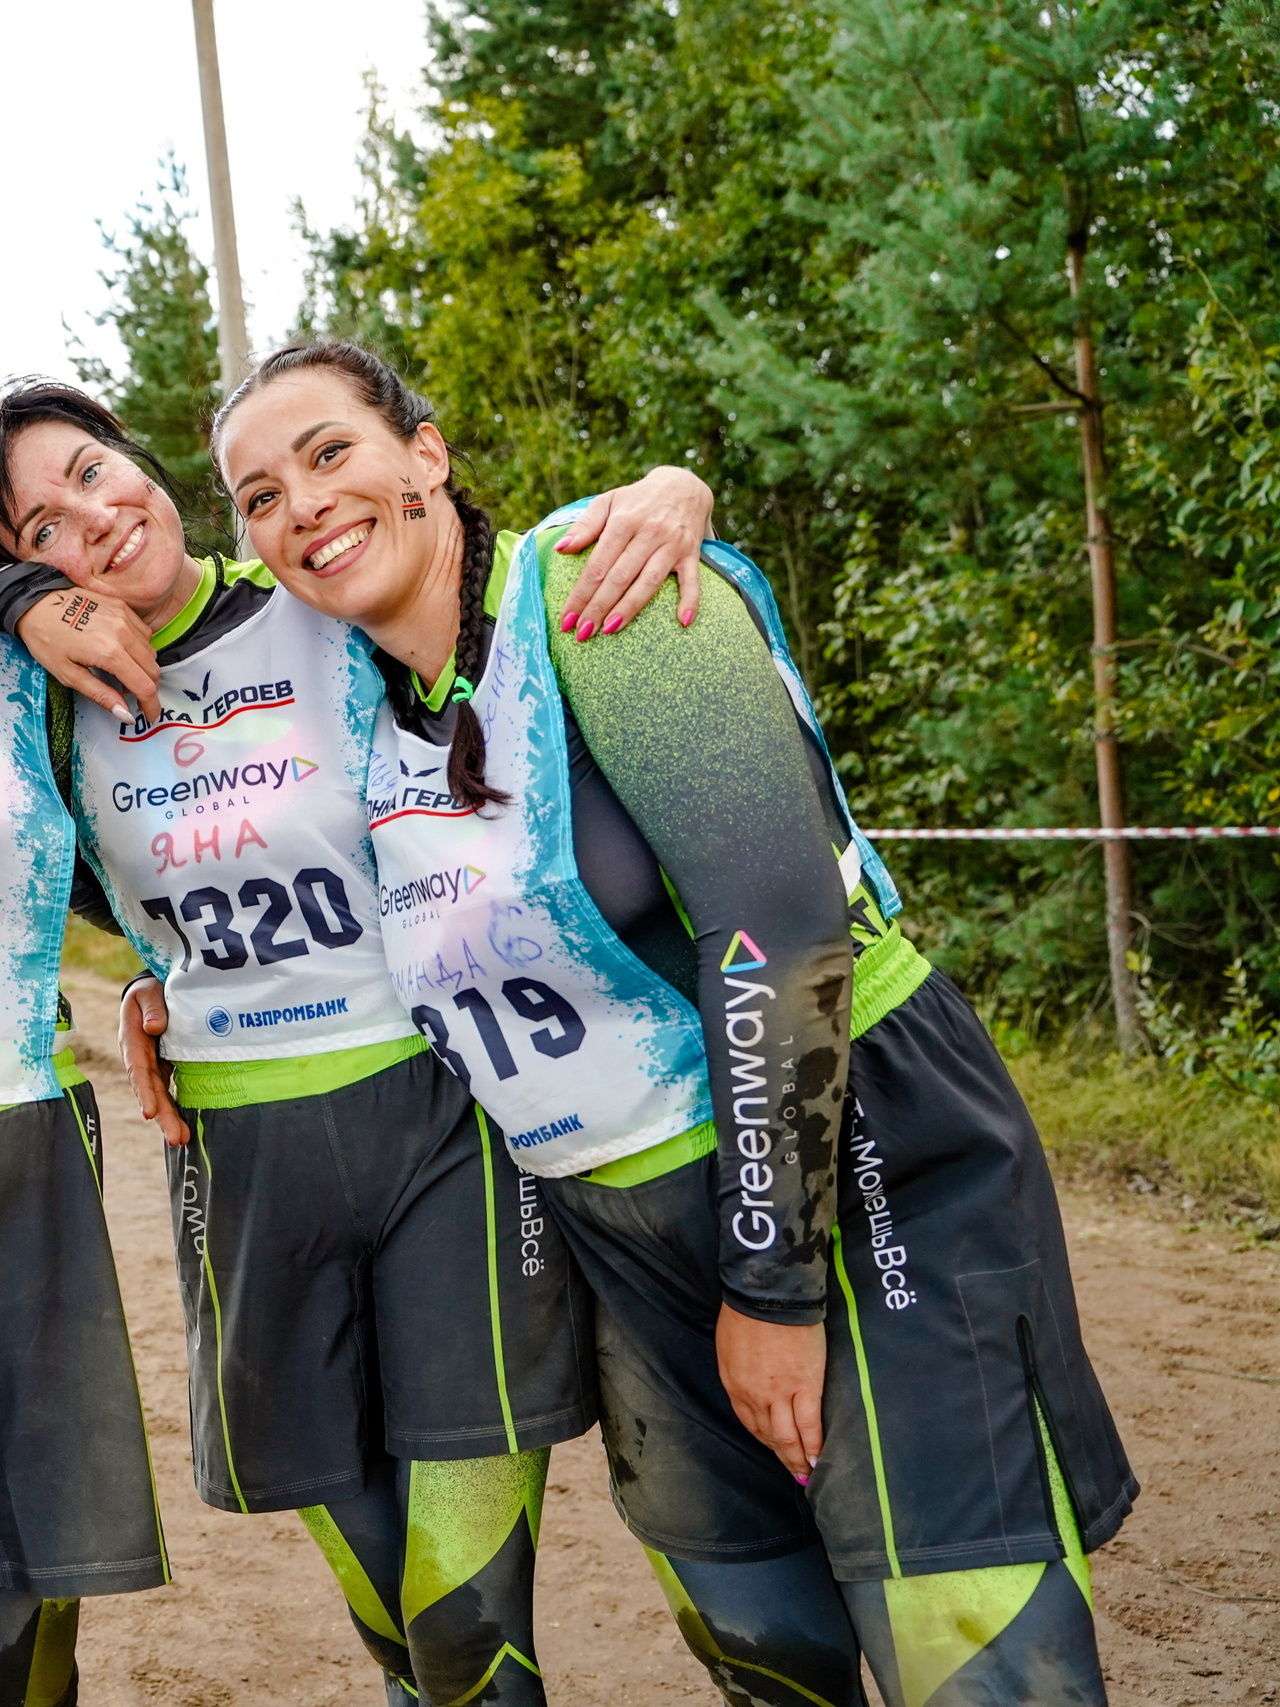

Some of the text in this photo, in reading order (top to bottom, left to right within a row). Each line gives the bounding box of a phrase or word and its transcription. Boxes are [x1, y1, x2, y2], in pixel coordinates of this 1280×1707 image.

[202, 679, 294, 724] ГЕРОЕВ
[173, 730, 206, 769] 6
[112, 758, 289, 813] Greenway
[165, 795, 250, 820] GLOBAL
[150, 819, 268, 877] ЯНА
[378, 868, 462, 917] Greenway
[140, 867, 364, 973] 7320
[401, 912, 441, 929] GLOBAL
[238, 997, 349, 1029] ГАЗПРОМБАНК
[722, 976, 777, 1251] Greenway
[779, 1034, 795, 1165] GLOBAL
